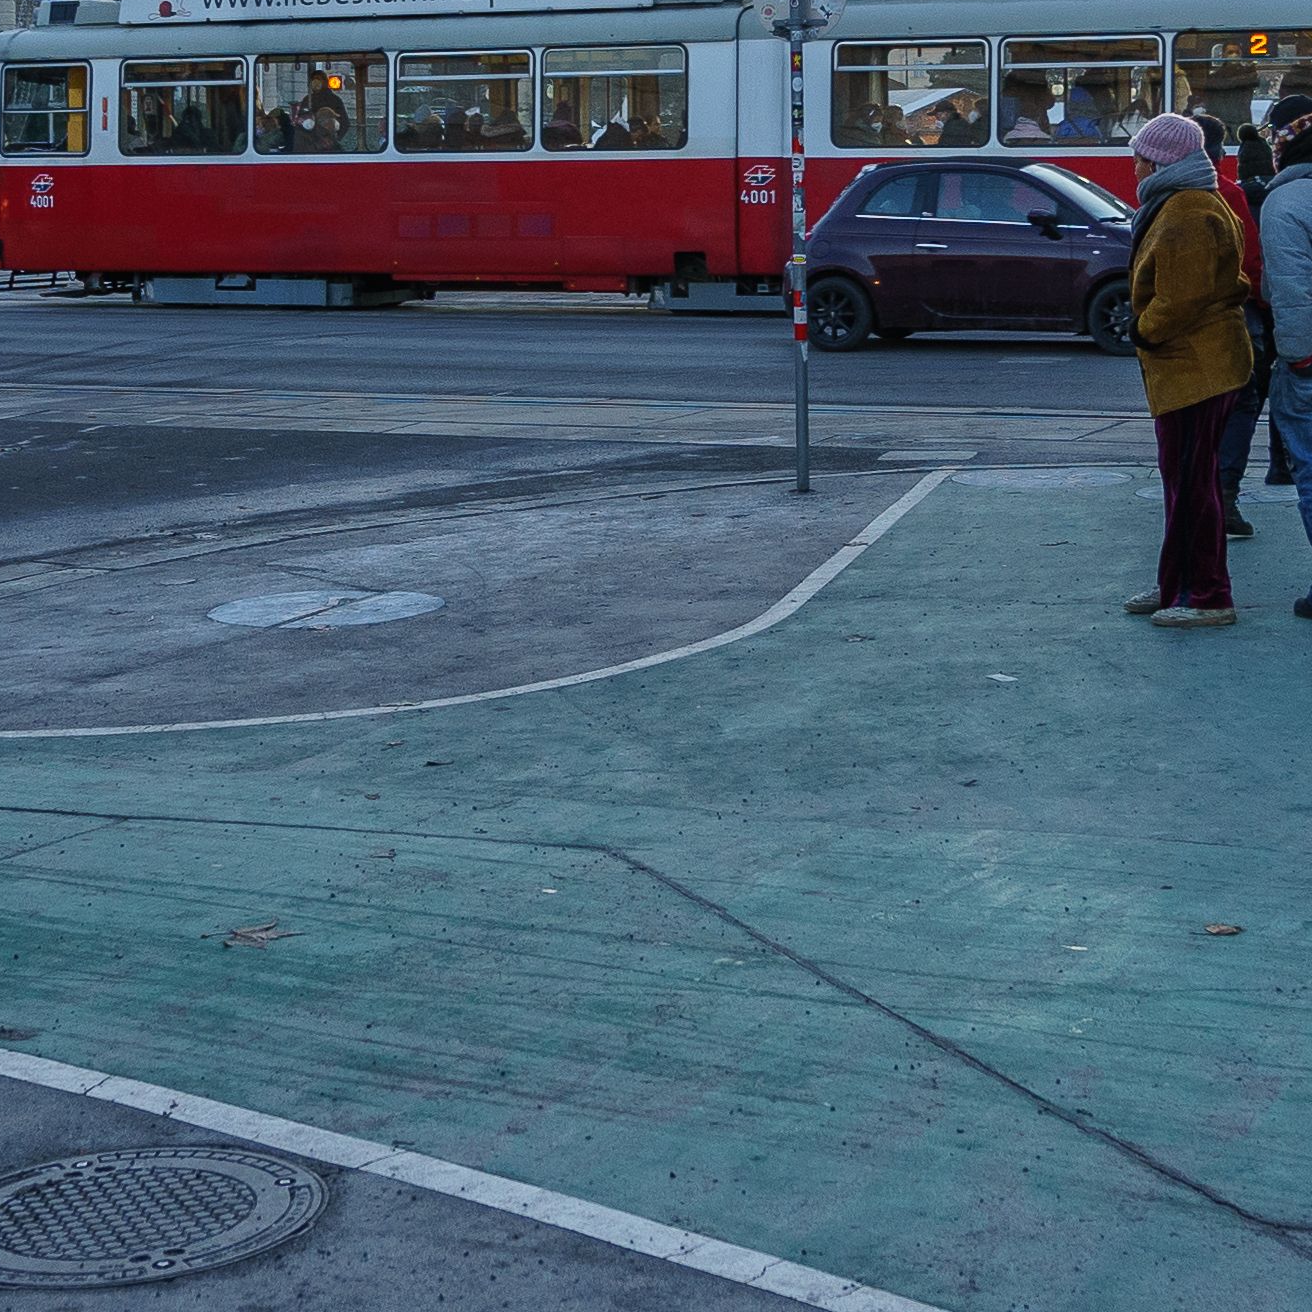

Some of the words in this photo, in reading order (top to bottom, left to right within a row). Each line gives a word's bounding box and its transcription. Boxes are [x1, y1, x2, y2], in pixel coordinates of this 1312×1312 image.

[1250, 33, 1267, 54] 2
[30, 195, 54, 208] 4001
[740, 189, 776, 204] 4001
